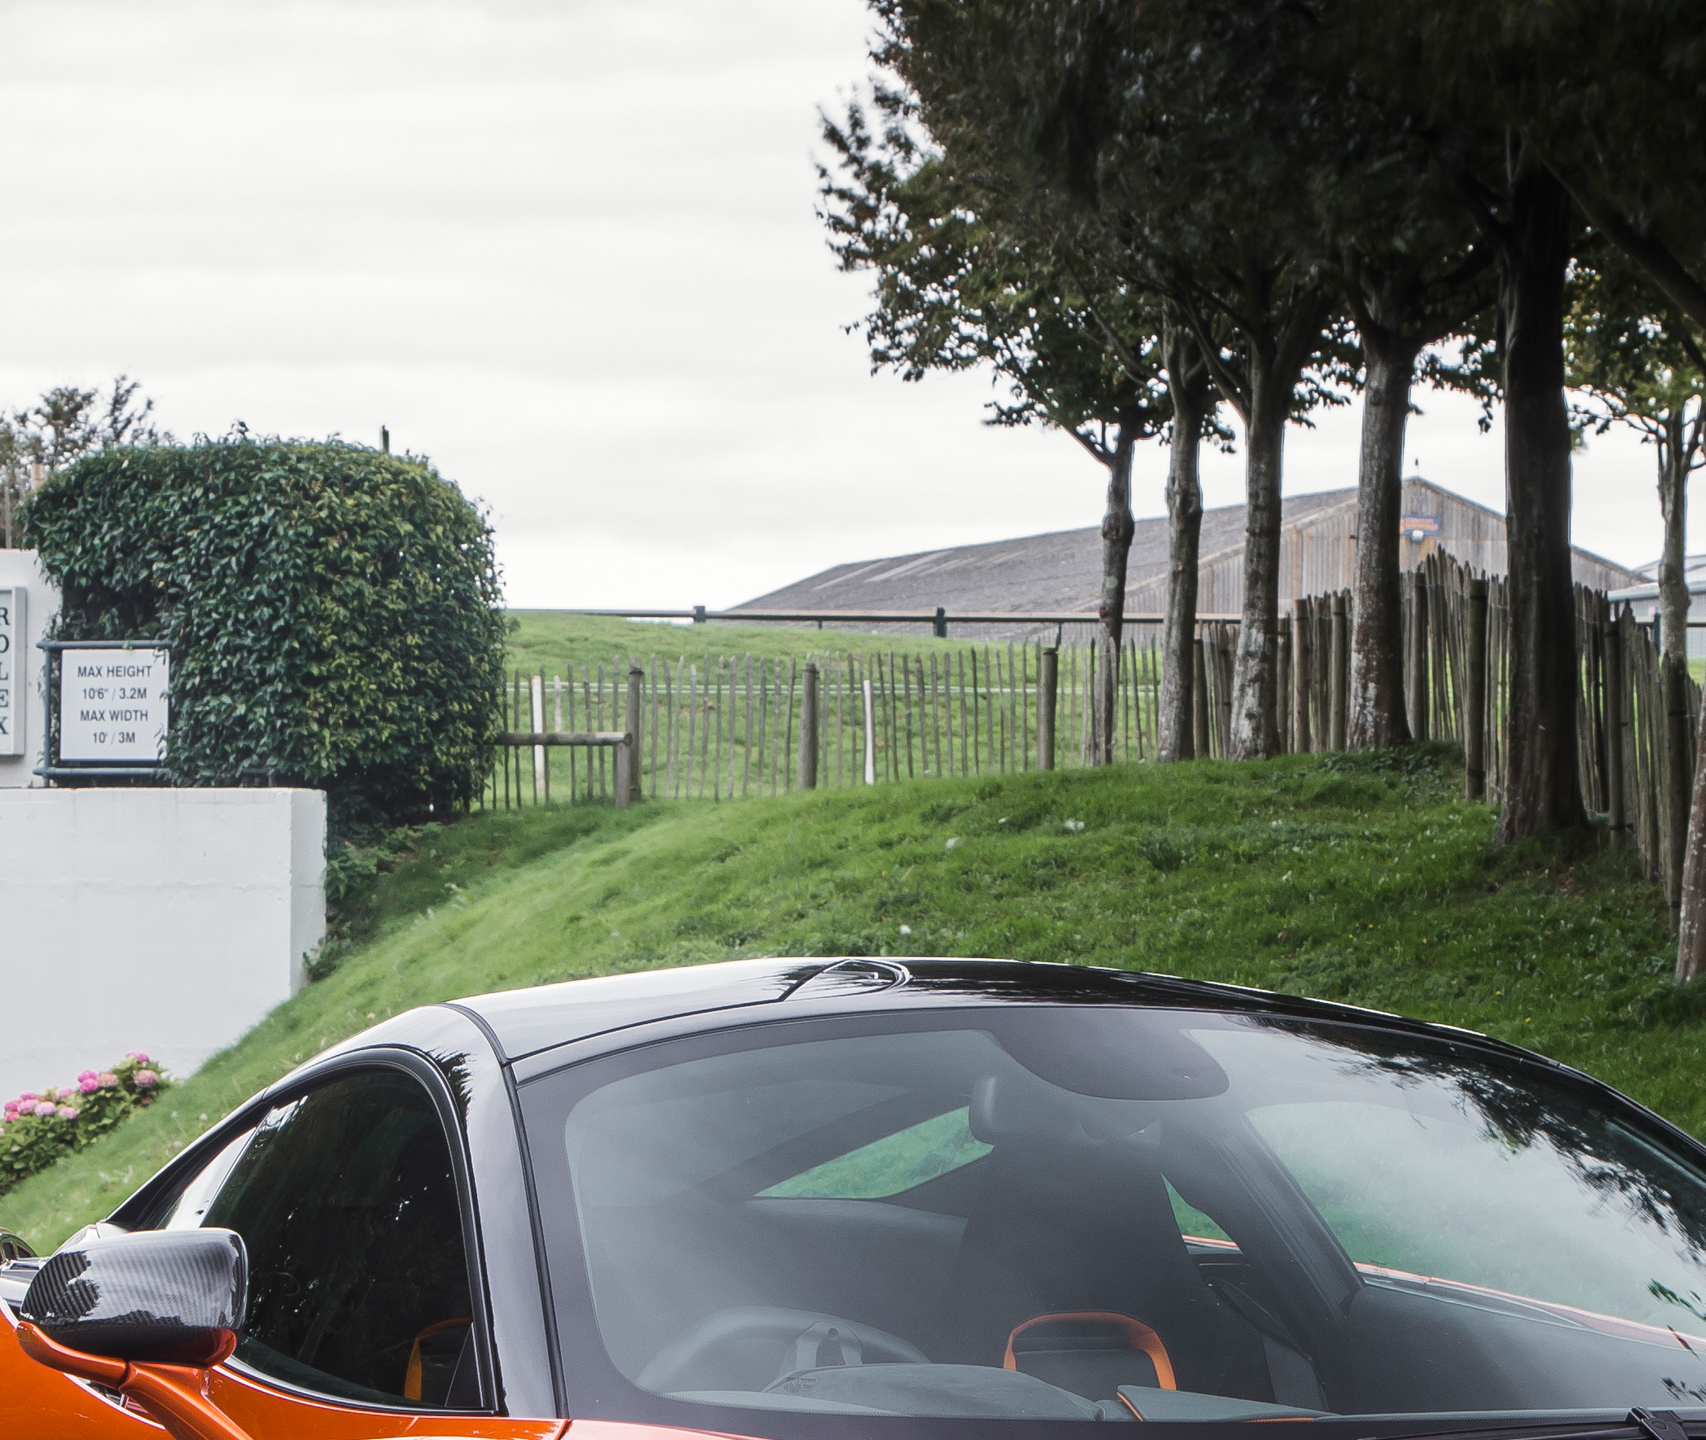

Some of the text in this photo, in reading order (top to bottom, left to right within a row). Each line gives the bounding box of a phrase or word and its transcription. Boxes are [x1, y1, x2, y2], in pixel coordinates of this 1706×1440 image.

[77, 665, 153, 678] MAX HEIGHT
[118, 687, 147, 700] 3.2M
[80, 709, 149, 722] MAX WIDTH
[118, 731, 136, 744] 3M
